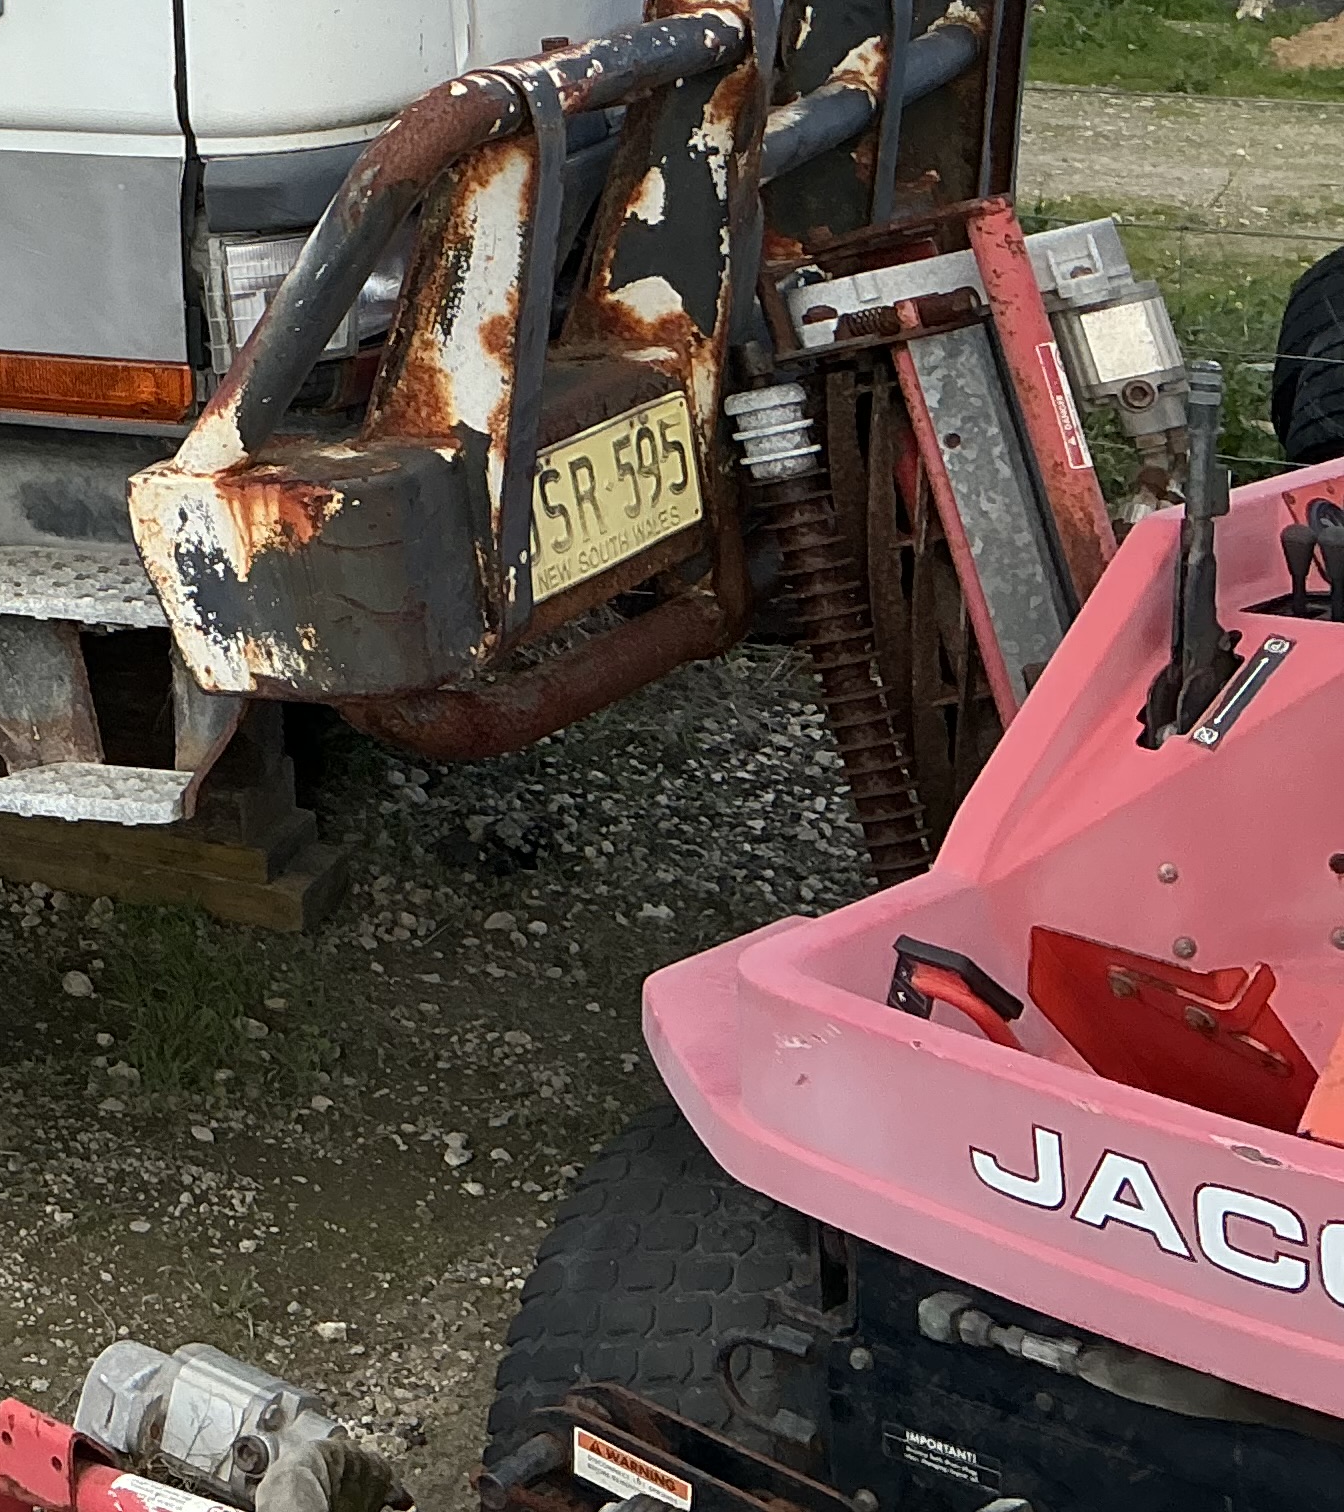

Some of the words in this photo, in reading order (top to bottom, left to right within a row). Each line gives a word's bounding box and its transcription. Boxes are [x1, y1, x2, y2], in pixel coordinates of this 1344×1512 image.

[537, 558, 572, 595] NEW
[577, 530, 631, 574] SOUTH
[631, 504, 682, 543] WALES
[968, 1123, 1344, 1309] JAC
[606, 1448, 677, 1493] WARNING
